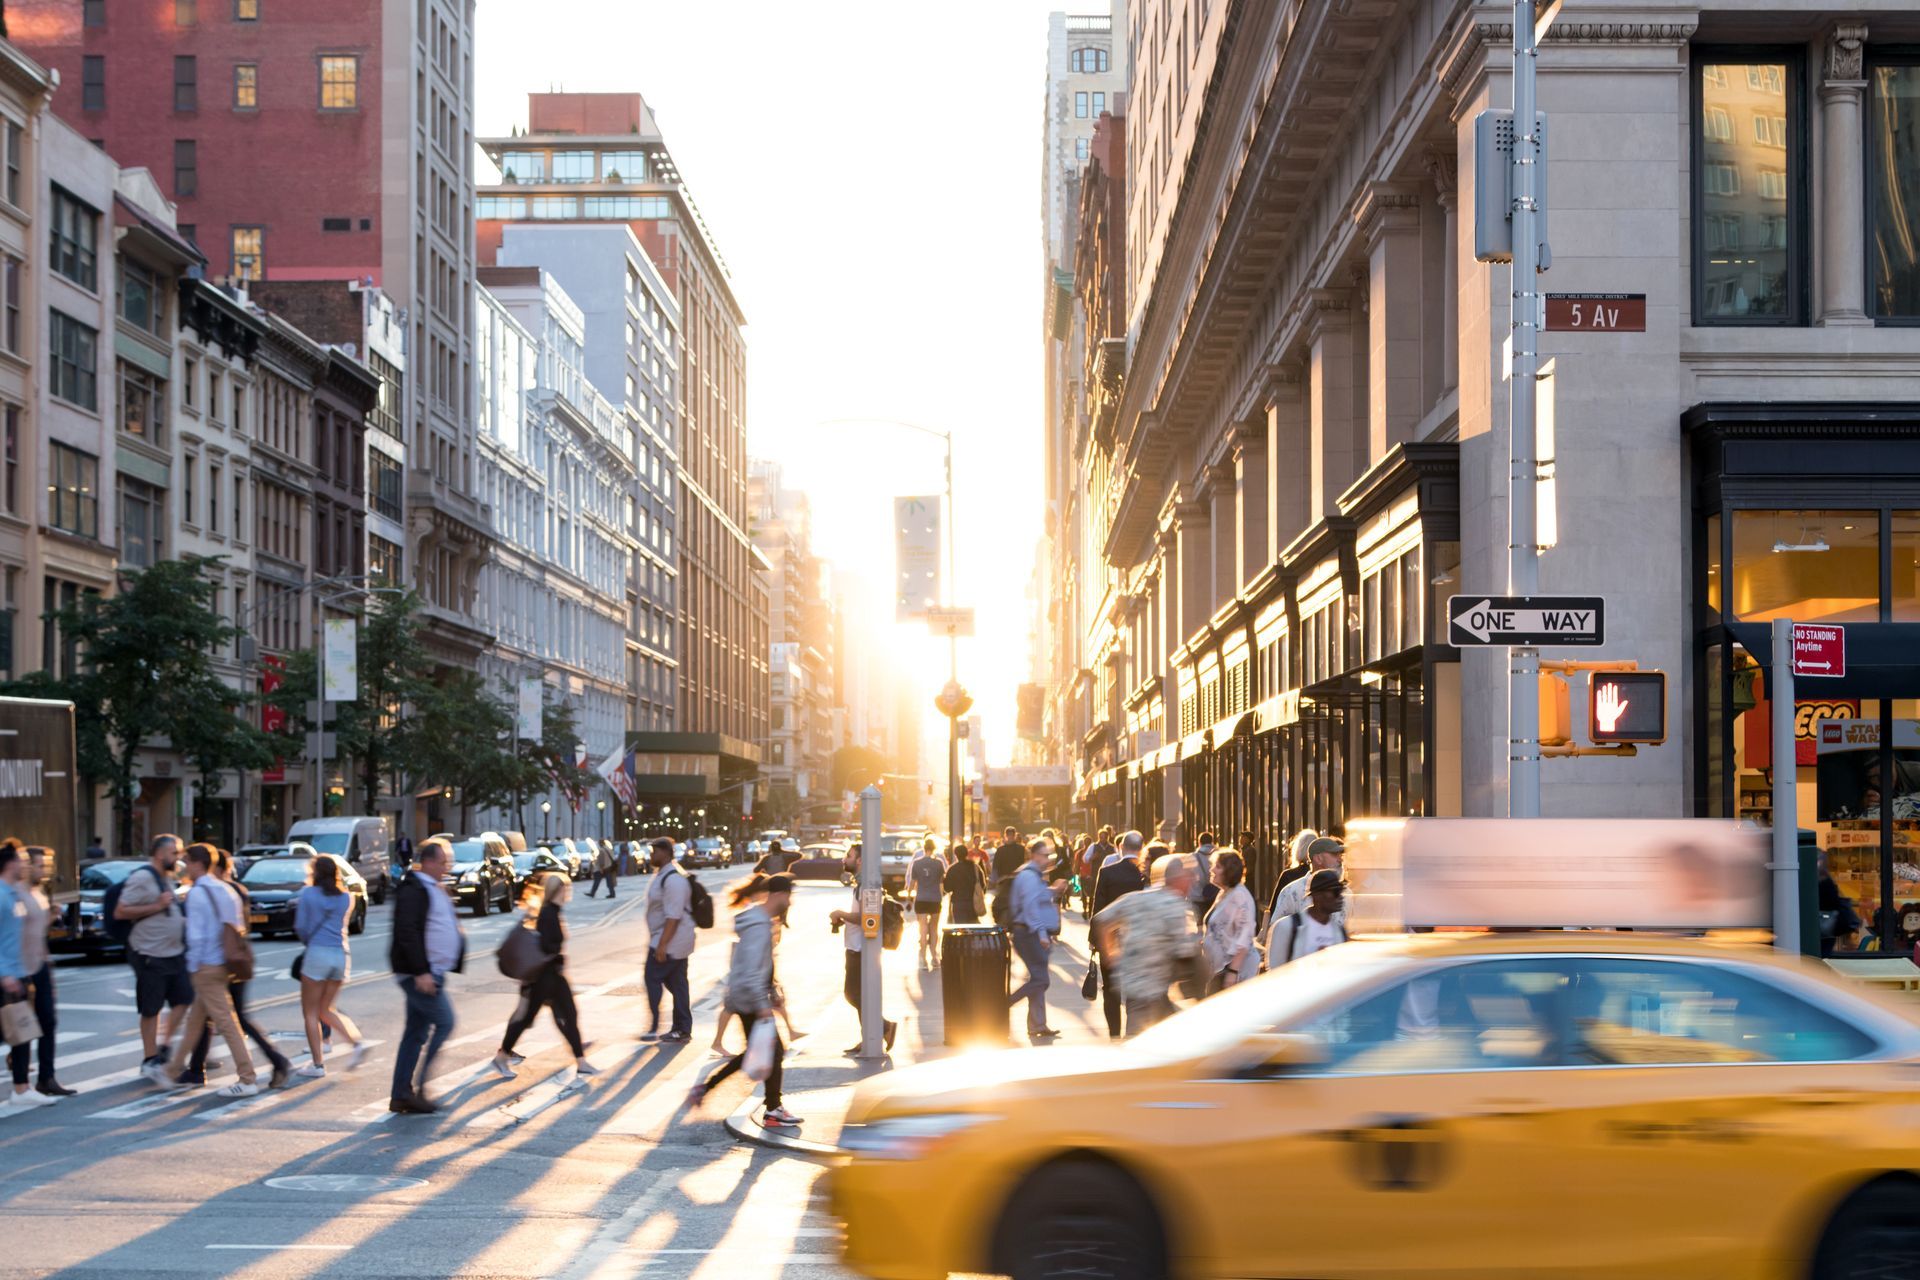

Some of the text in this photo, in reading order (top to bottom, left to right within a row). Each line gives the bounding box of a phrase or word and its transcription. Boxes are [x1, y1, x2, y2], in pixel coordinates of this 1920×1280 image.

[1571, 303, 1619, 328] 5 Av
[1470, 611, 1591, 631] ONE WAY
[1795, 630, 1837, 641] NO STANDING
[1796, 640, 1823, 653] Anytime
[1795, 703, 1854, 738] EG
